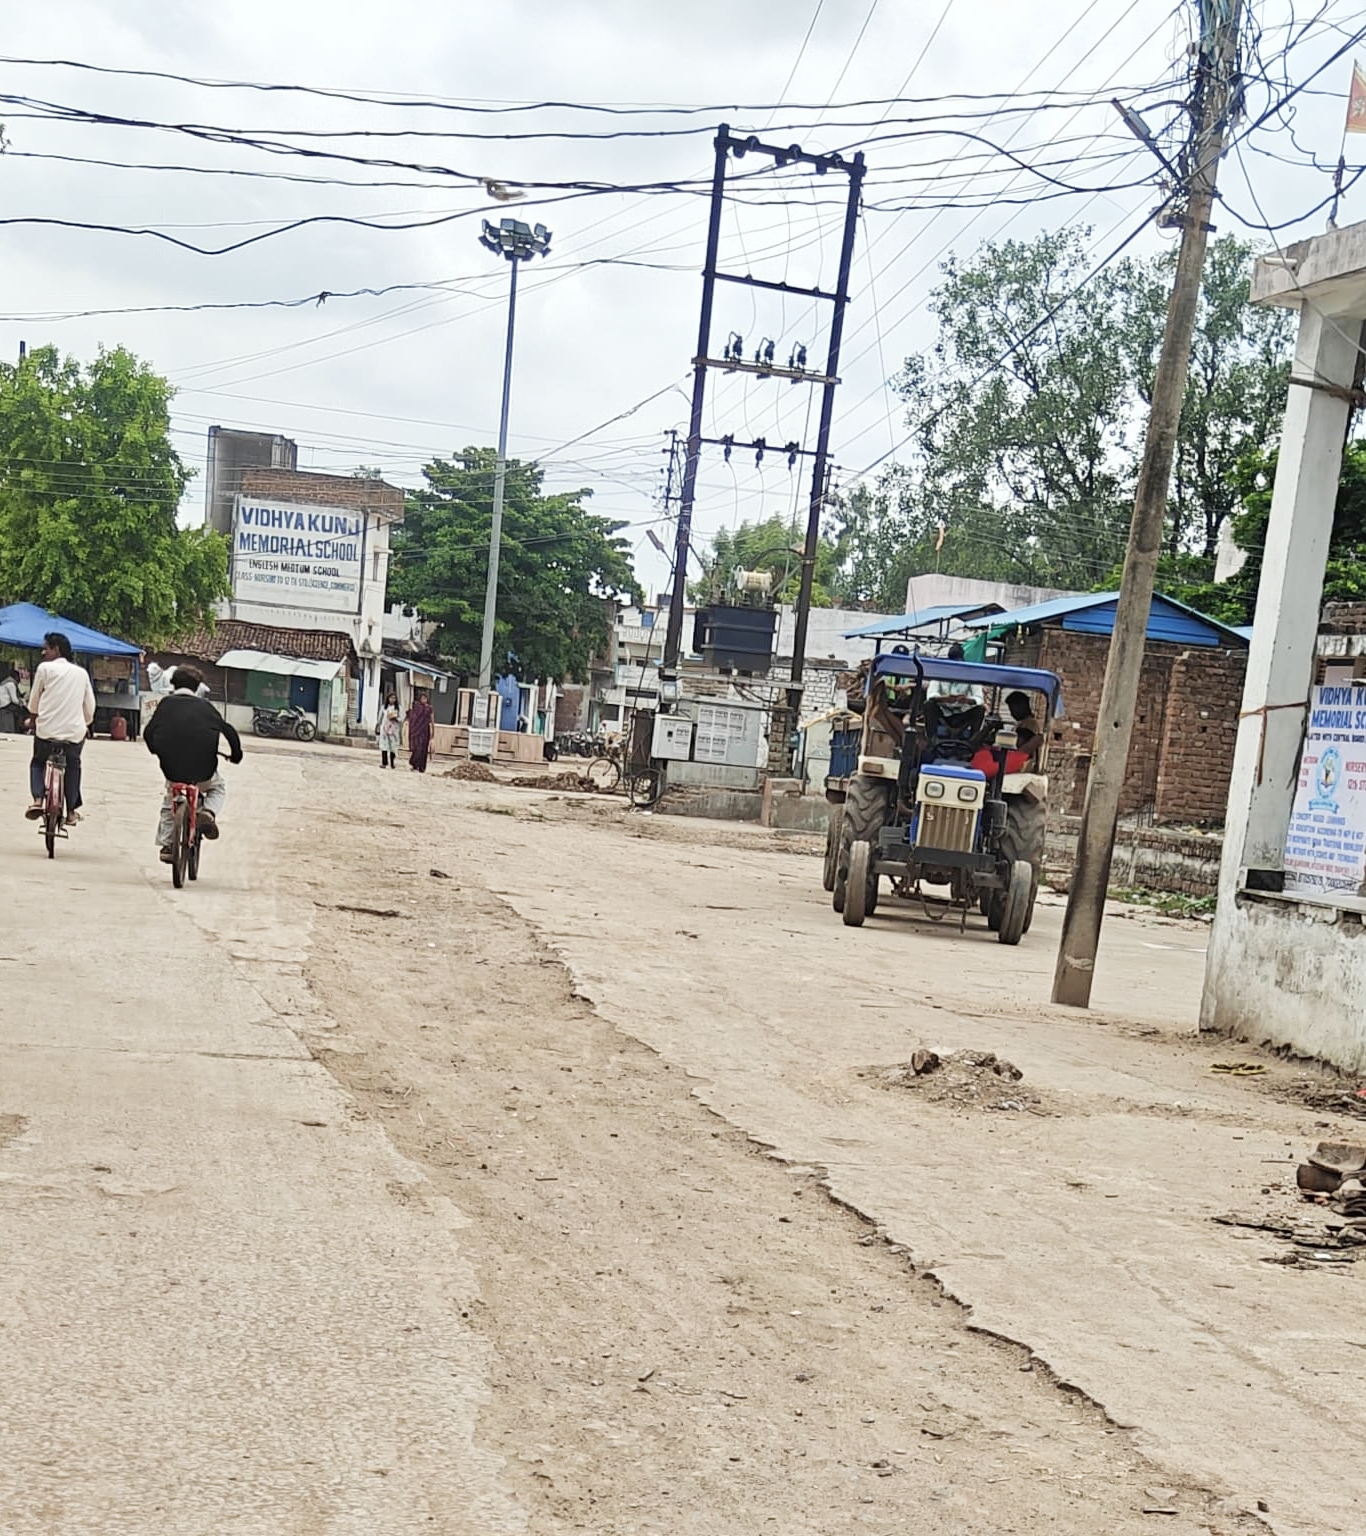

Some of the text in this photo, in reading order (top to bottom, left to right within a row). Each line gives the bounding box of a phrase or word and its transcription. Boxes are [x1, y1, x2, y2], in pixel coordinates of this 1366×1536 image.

[241, 506, 360, 537] VIDHYA KUNJ
[239, 532, 359, 562] MEMORIAL SCHOOL
[280, 562, 310, 574] MEDIUM
[312, 566, 340, 577] SCHOOL
[1319, 687, 1353, 706] VIDHYA
[1311, 709, 1353, 729] MEMORIAL
